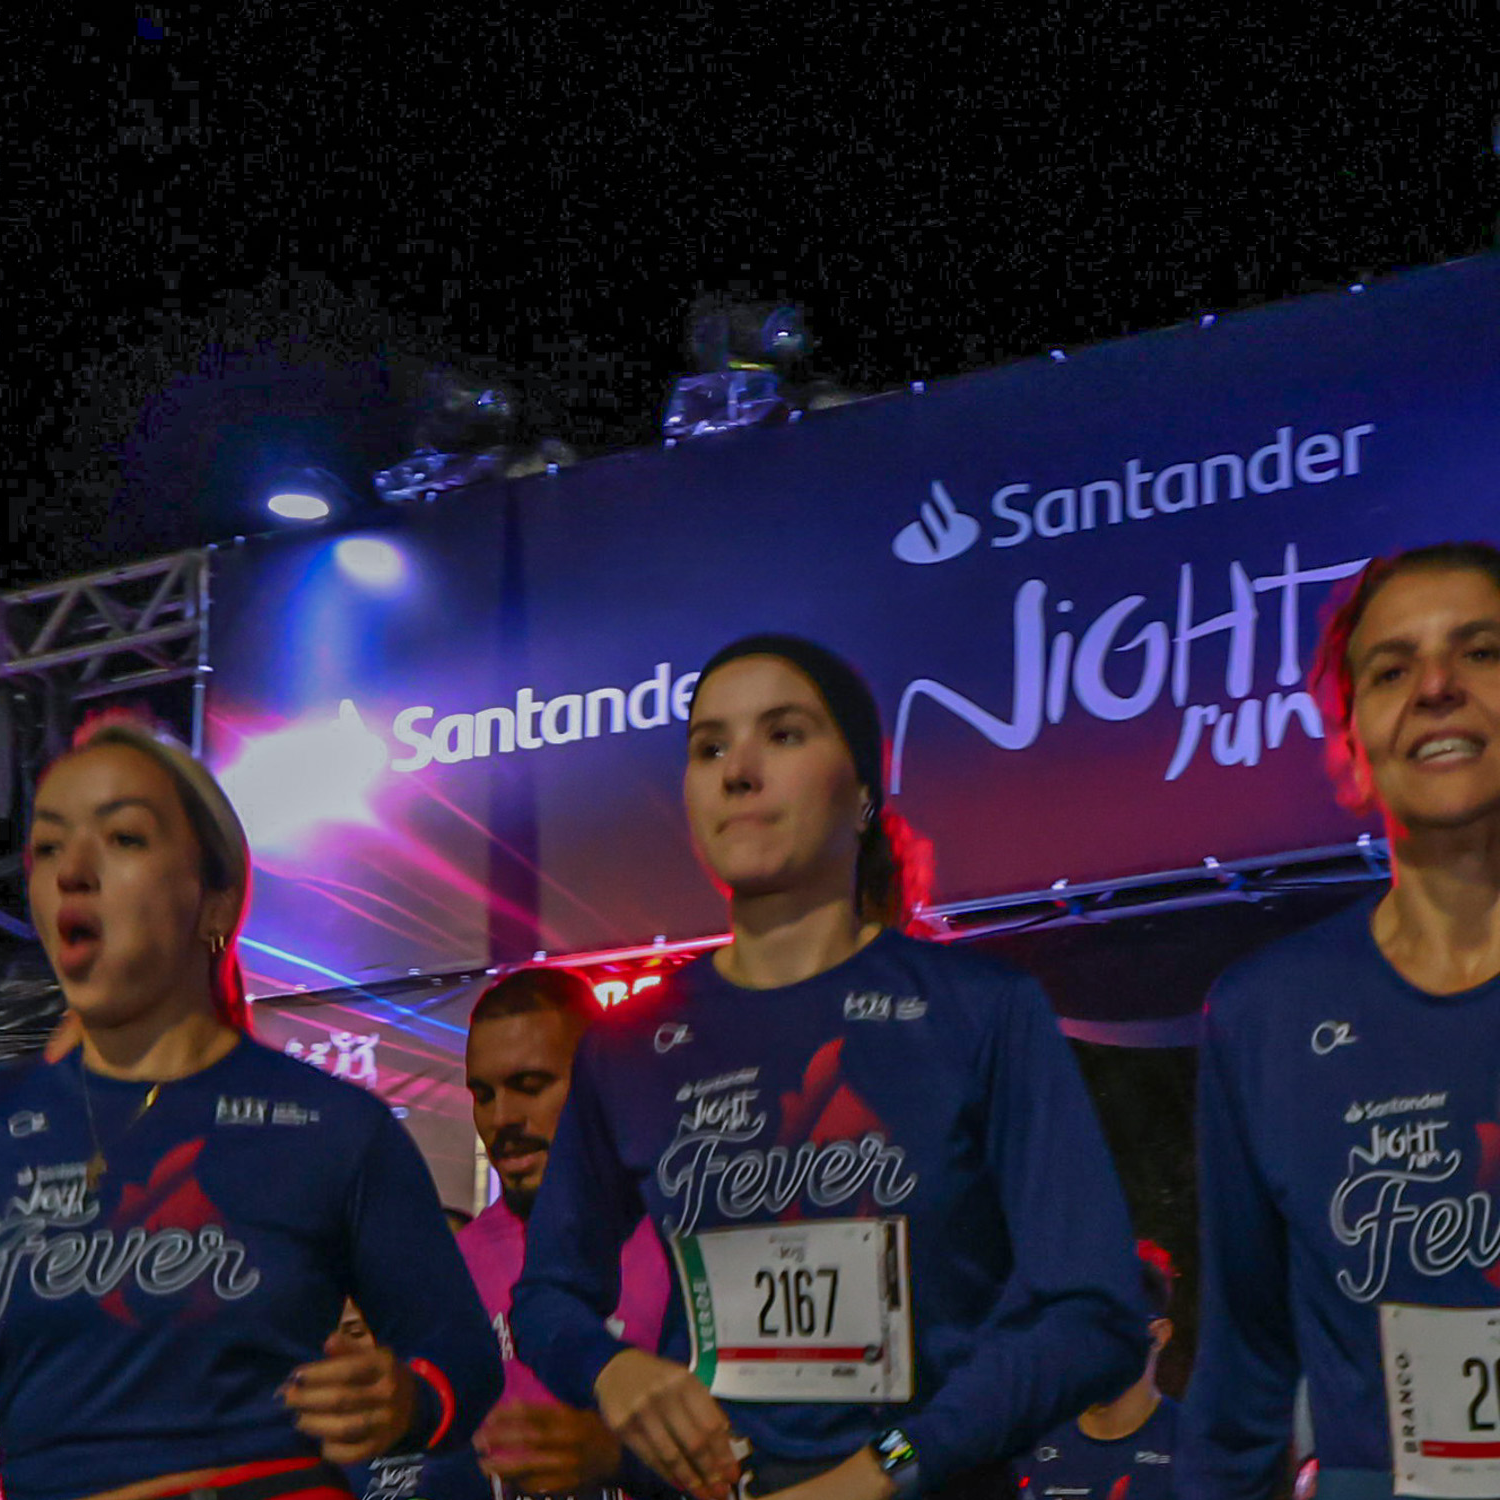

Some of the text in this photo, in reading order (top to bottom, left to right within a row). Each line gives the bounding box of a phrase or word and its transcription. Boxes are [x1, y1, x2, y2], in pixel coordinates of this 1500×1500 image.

[990, 424, 1375, 548] Santander
[391, 662, 703, 773] Santande
[1165, 692, 1325, 781] run
[656, 1112, 919, 1237] Fever
[693, 1277, 717, 1353] VERDE
[755, 1266, 840, 1338] 2167
[1395, 1353, 1419, 1453] BRANCO
